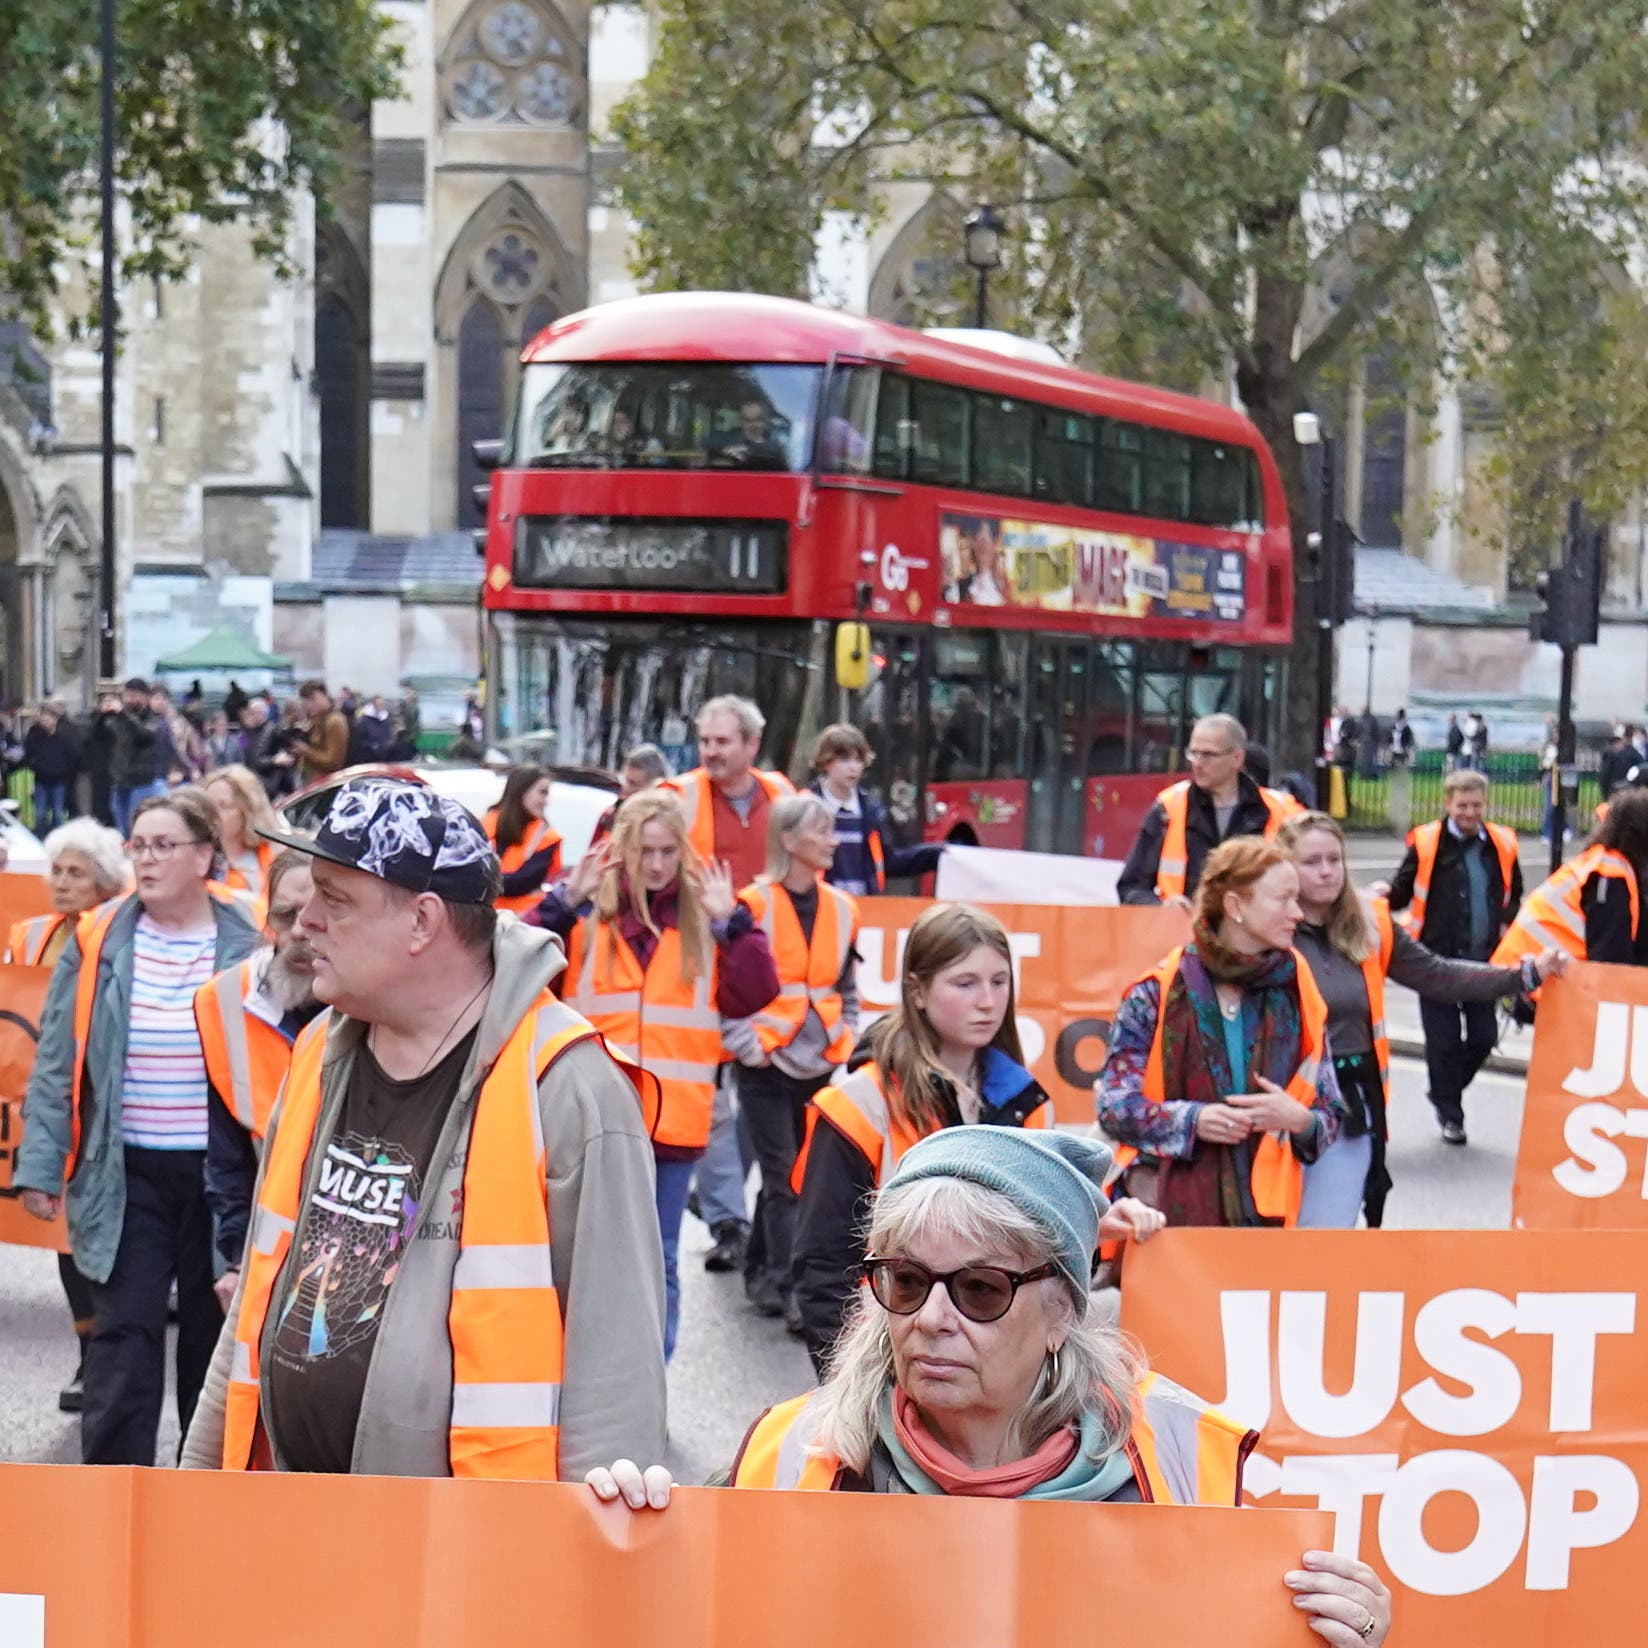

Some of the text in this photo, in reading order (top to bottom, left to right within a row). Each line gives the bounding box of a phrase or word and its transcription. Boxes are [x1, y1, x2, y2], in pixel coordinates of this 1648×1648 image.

[539, 532, 759, 580] Waterloo 11
[1218, 1288, 1638, 1438] JUST
